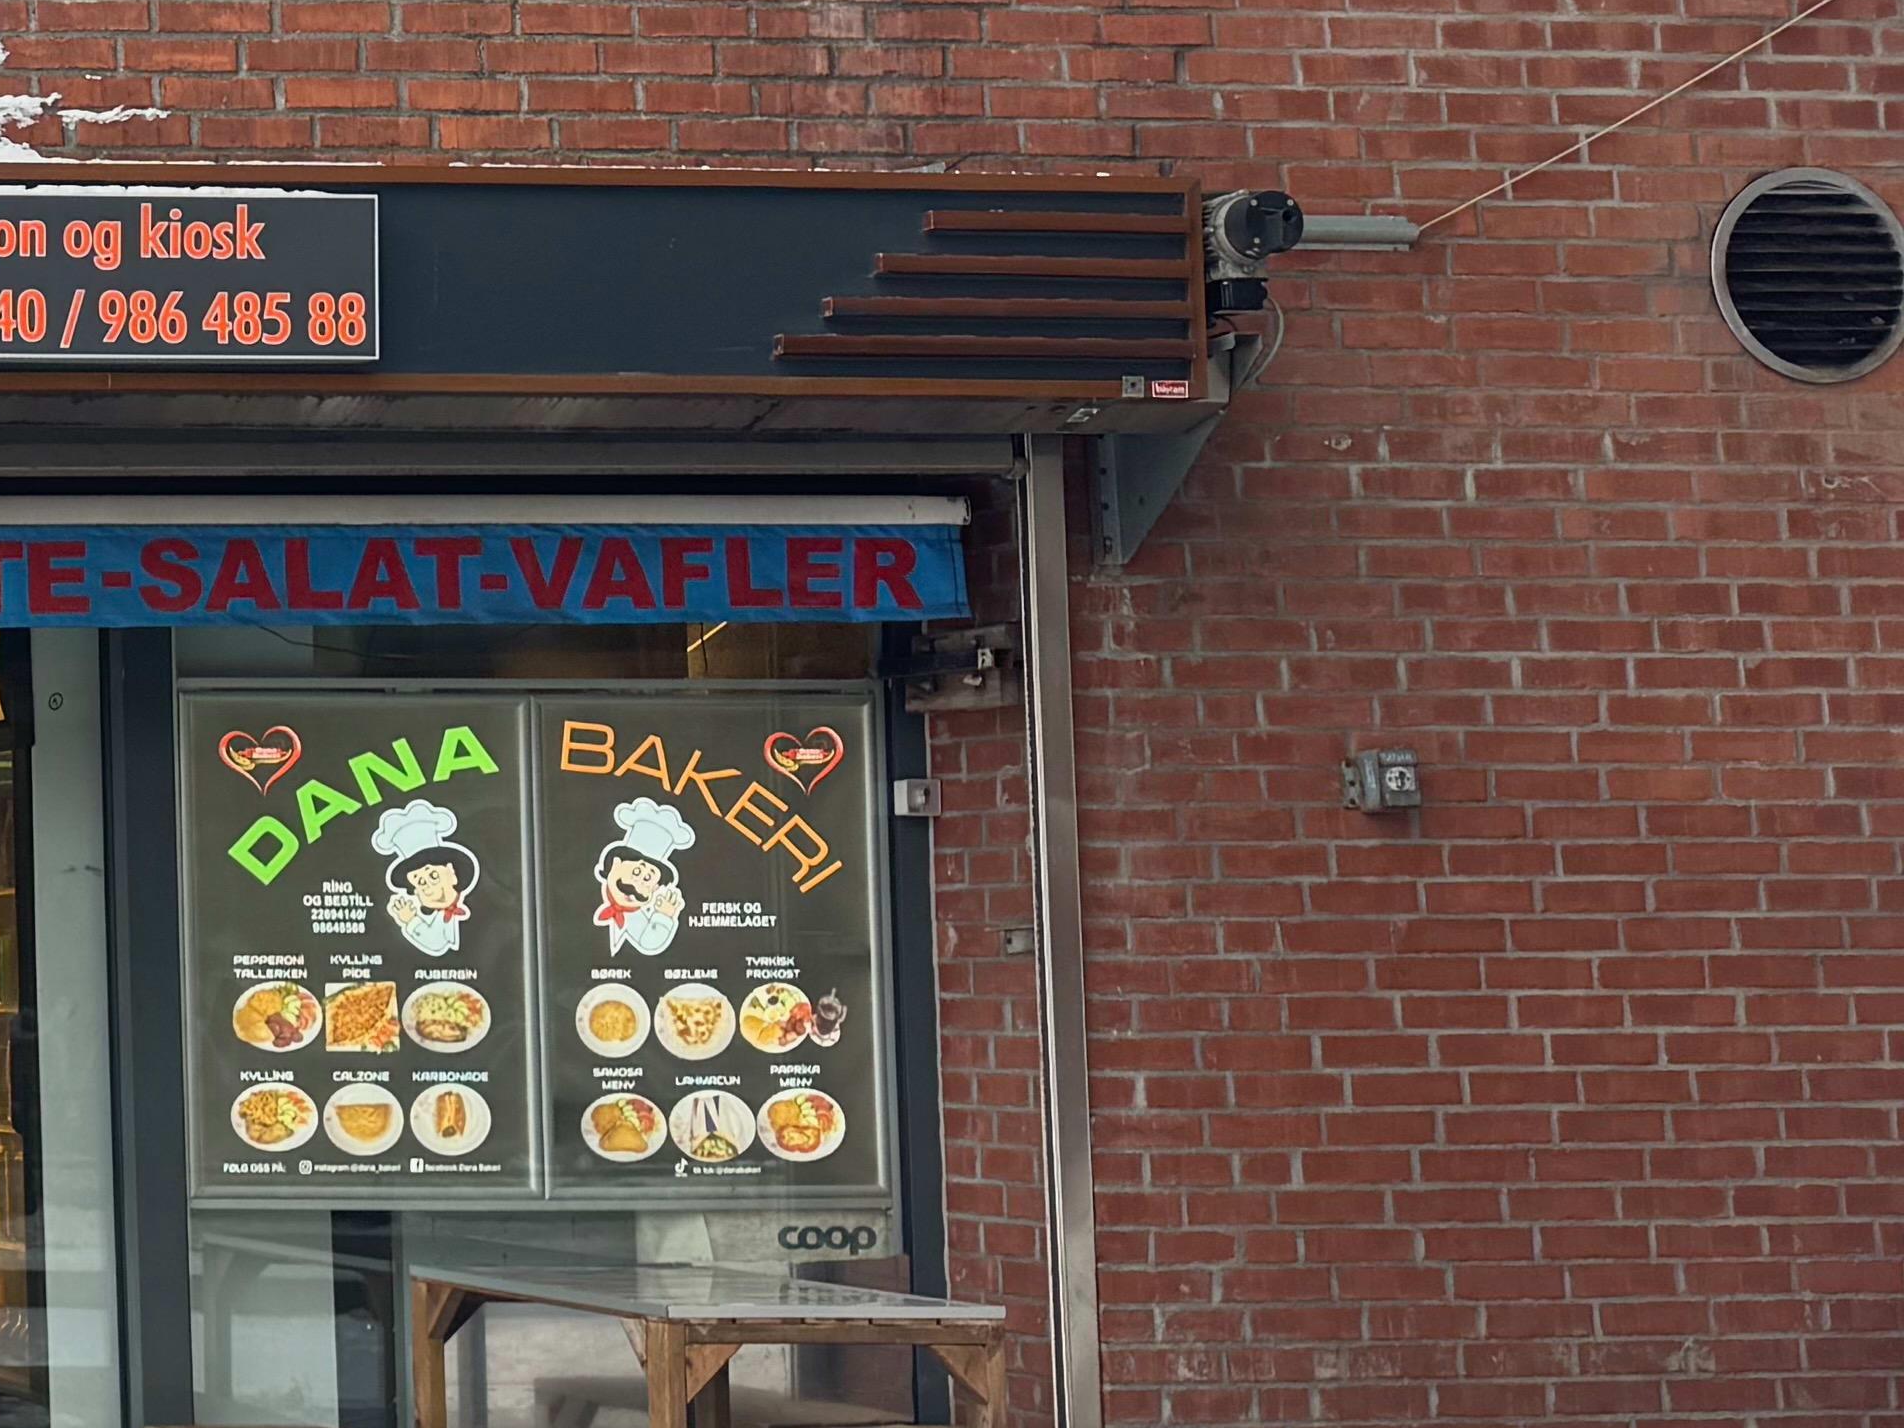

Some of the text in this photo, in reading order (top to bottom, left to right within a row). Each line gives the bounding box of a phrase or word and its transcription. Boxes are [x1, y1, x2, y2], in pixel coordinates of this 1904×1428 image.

[62, 217, 122, 271] og
[140, 202, 266, 260] kiosk
[59, 289, 87, 349] /
[98, 290, 187, 345] 986
[202, 291, 292, 346] 485
[307, 292, 367, 347] 88
[228, 725, 500, 886] DANA
[559, 720, 843, 894] BAKERI
[303, 894, 322, 907] OG
[688, 915, 777, 928] HJEMMELAGET
[702, 902, 762, 914] FERSK OG
[777, 1224, 878, 1256] coop
